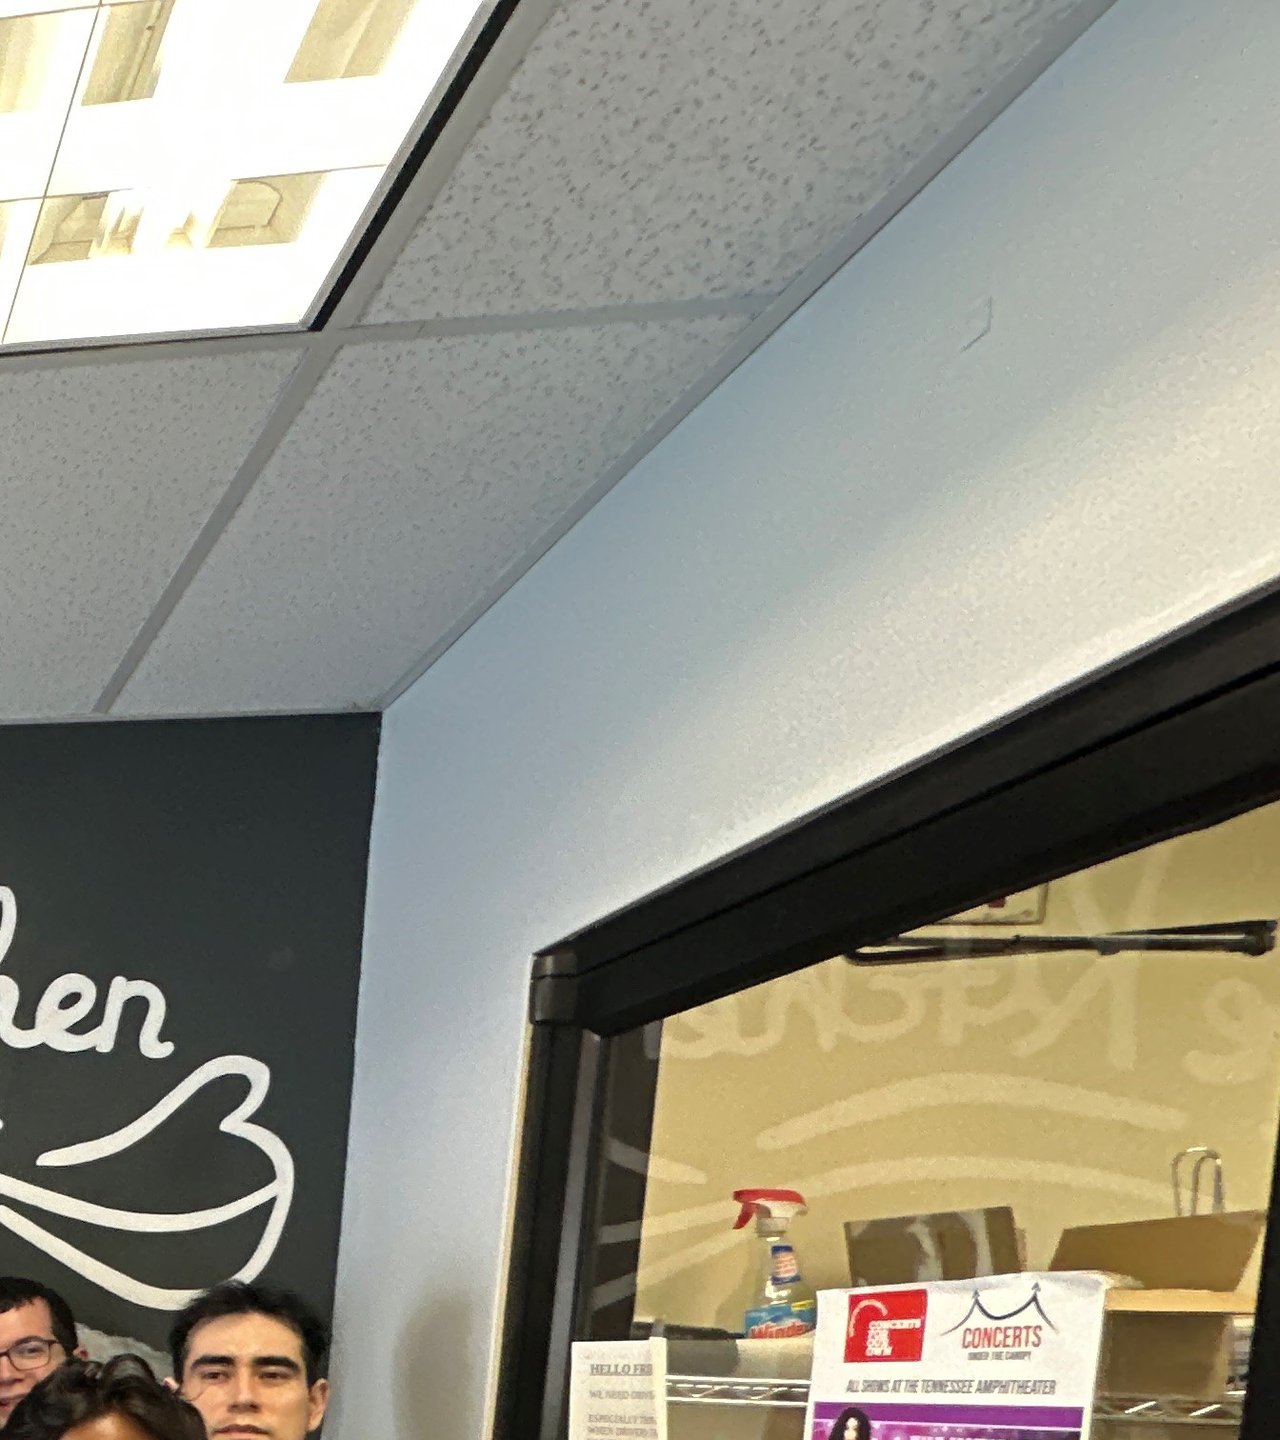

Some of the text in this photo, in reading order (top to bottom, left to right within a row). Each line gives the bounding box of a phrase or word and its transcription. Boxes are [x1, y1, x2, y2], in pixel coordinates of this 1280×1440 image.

[961, 1325, 1042, 1349] CONCERTS
[590, 1364, 631, 1376] HELLO
[845, 1379, 1057, 1396] ALL SHOWS AT THE TENNESSEE AMPHITHEATER
